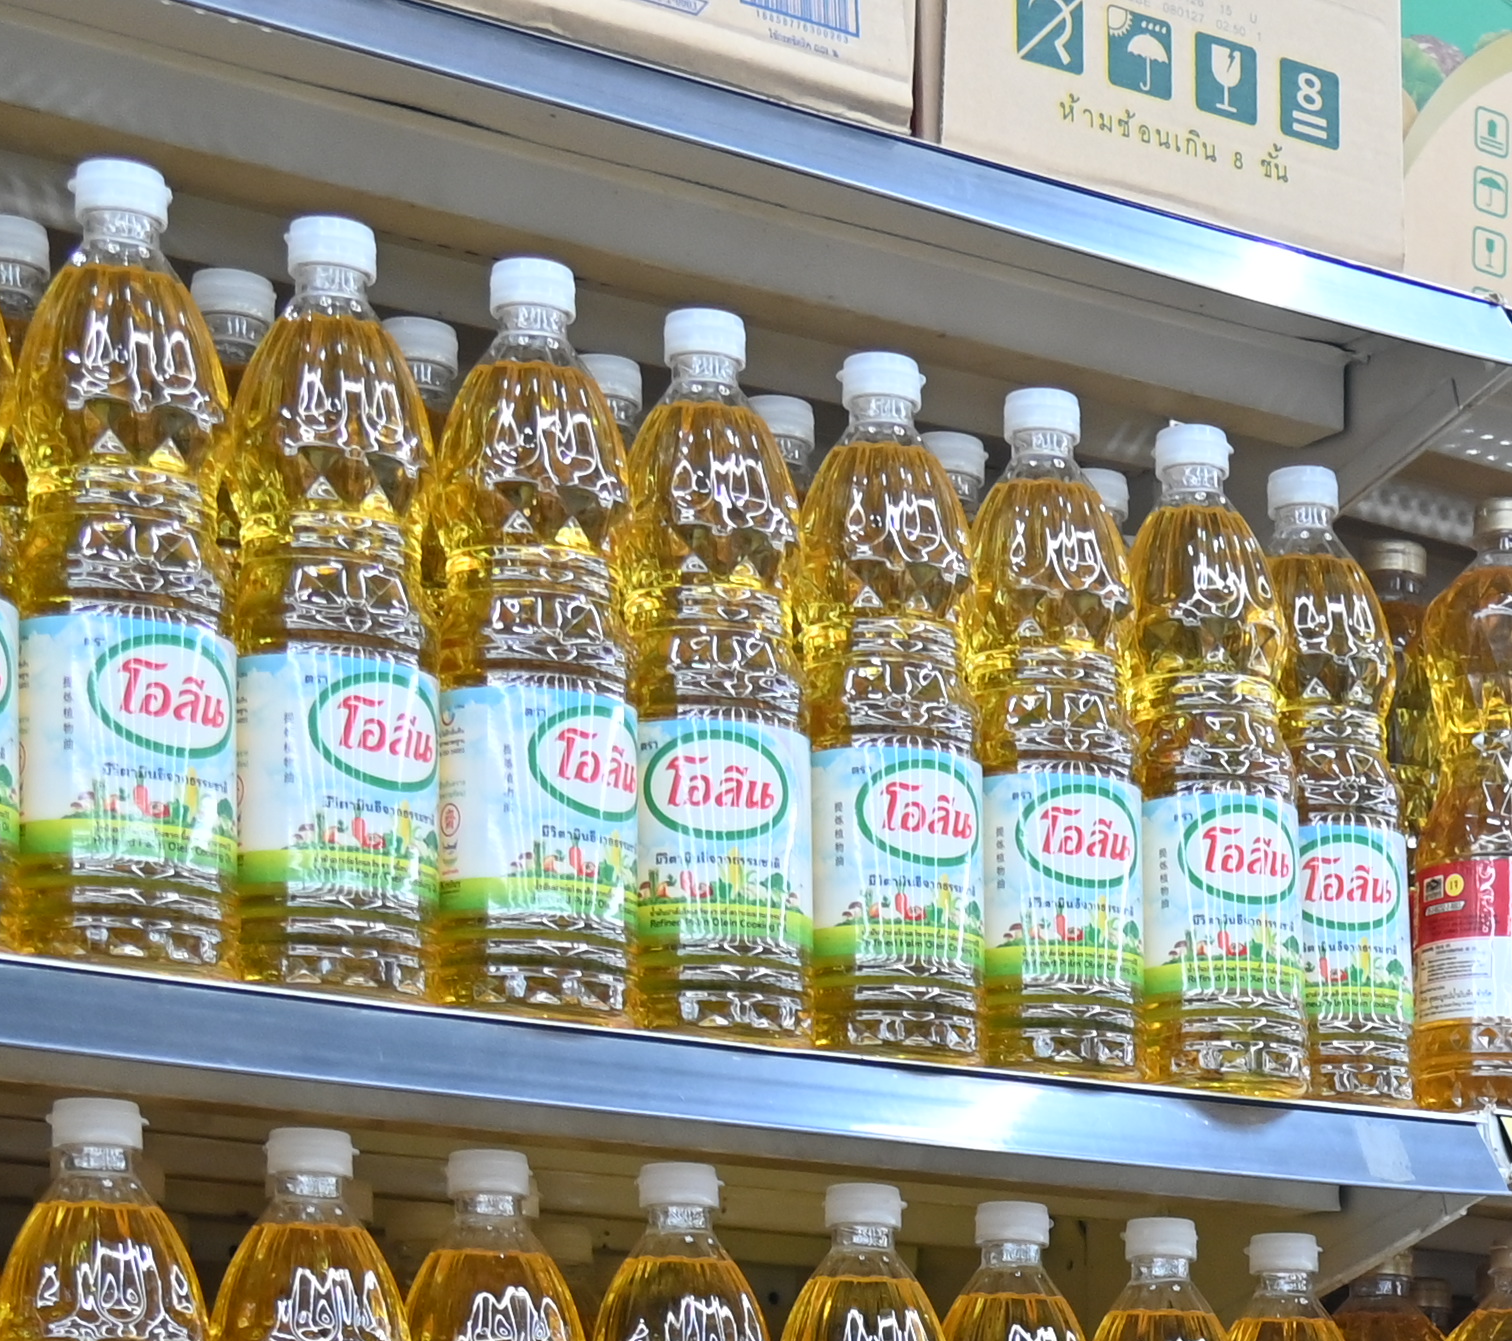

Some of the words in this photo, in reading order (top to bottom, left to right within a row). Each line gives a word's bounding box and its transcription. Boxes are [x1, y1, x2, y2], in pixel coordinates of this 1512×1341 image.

[1296, 72, 1324, 112] 8
[1060, 92, 1218, 164] ห้ามซ้อนเกิน
[1233, 151, 1245, 171] 8
[1259, 143, 1290, 184] ชั้น
[123, 658, 223, 727] โอลีน
[342, 696, 431, 762] โอลีน
[559, 728, 634, 792] โอลีน
[668, 756, 774, 809] โอลีน
[886, 782, 971, 838] โอลีน
[1043, 807, 1127, 860] โอลีน
[1204, 827, 1288, 876] โอลีน
[1304, 857, 1390, 905] โอลีน
